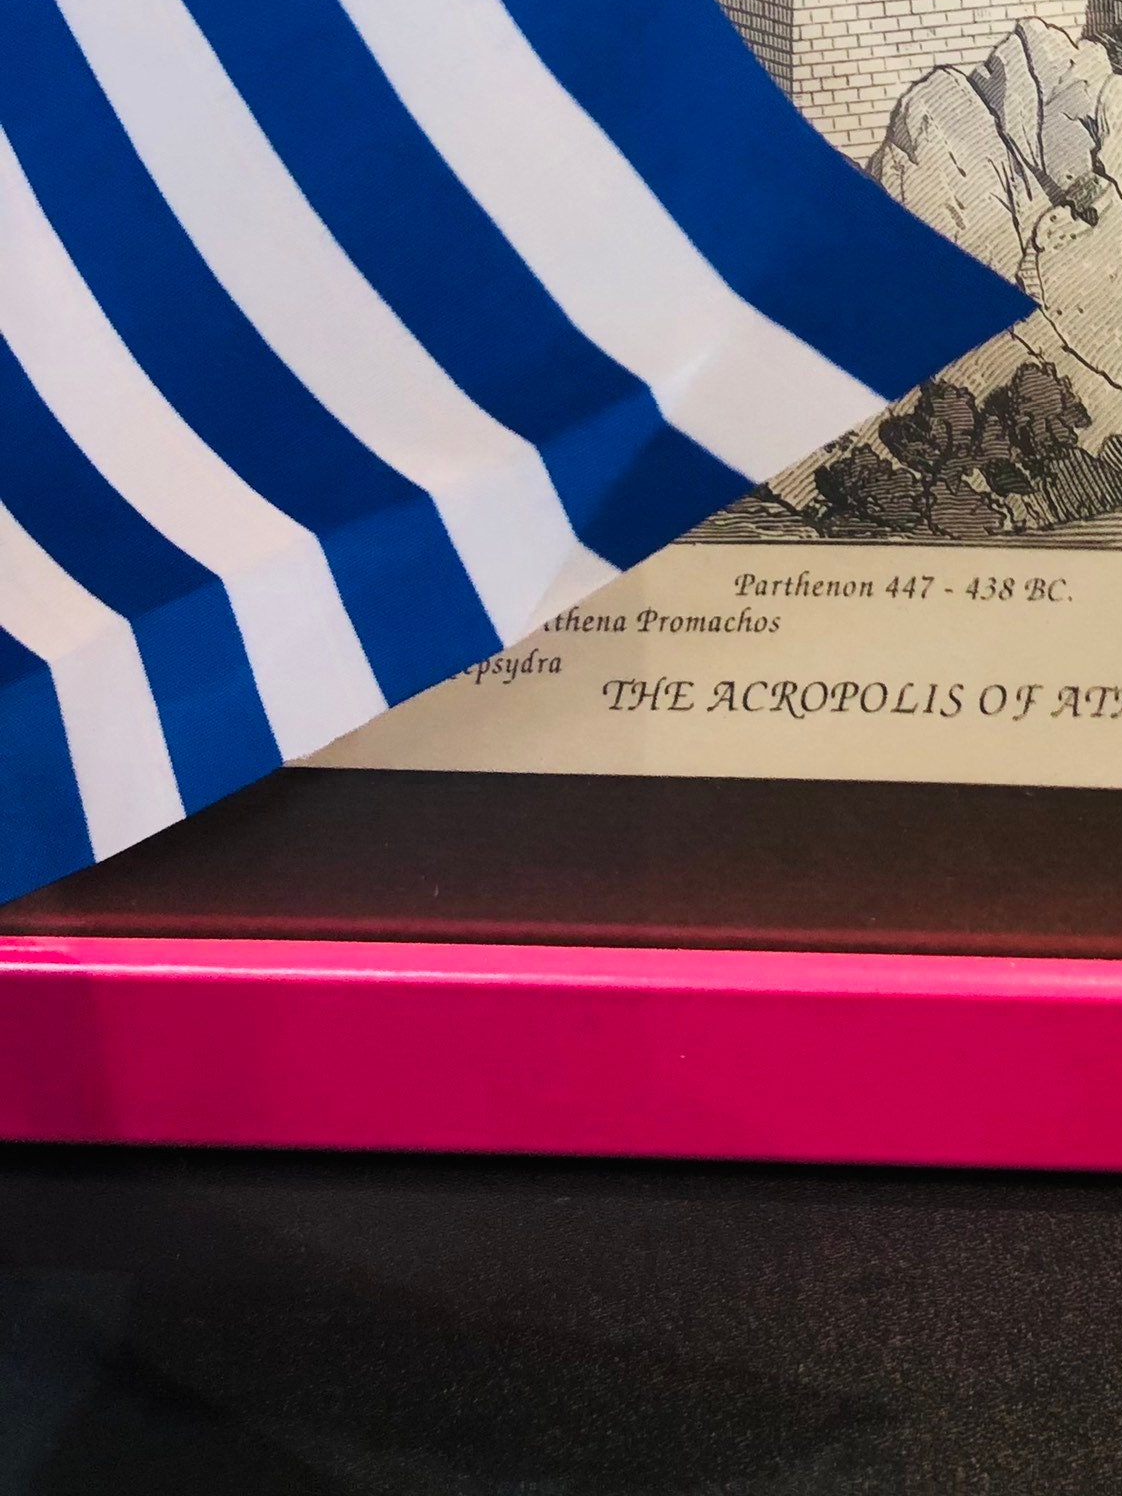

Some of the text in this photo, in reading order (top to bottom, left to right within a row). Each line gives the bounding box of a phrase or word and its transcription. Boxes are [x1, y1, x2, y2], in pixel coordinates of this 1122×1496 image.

[733, 571, 874, 599] Parthenon
[885, 574, 935, 600] 447
[964, 576, 1015, 602] 438
[1024, 577, 1073, 603] BC.
[543, 605, 782, 634] thena Promachos
[601, 678, 696, 713] THE
[707, 681, 964, 721] ACROPOLIS
[978, 684, 1046, 722] OF
